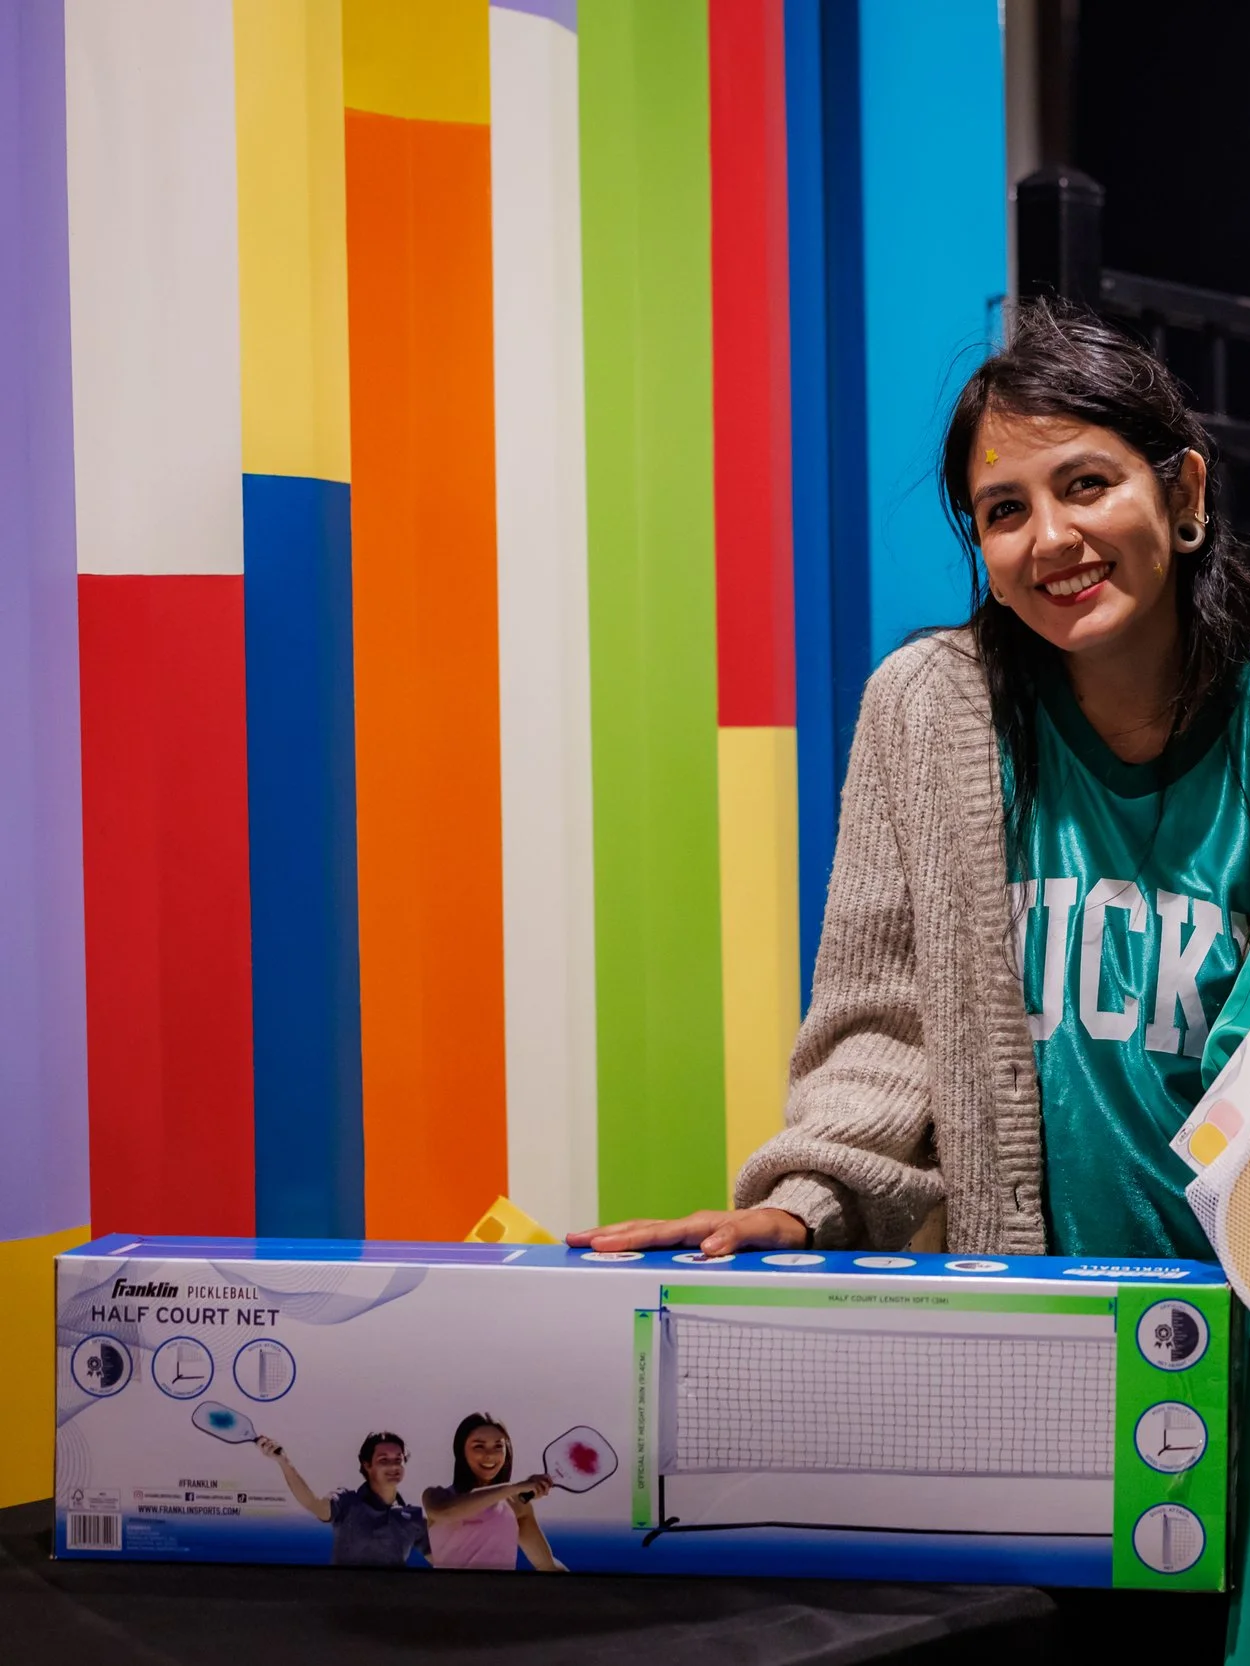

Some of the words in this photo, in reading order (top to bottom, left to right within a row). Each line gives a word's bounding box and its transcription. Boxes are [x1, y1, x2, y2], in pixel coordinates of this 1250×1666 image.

[1007, 876, 1249, 1059] UCK
[187, 1286, 258, 1300] PICKLEBALL
[879, 1295, 911, 1303] LENGTH
[92, 1305, 149, 1323] HALF
[156, 1307, 229, 1325] COURT
[237, 1309, 280, 1326] NET
